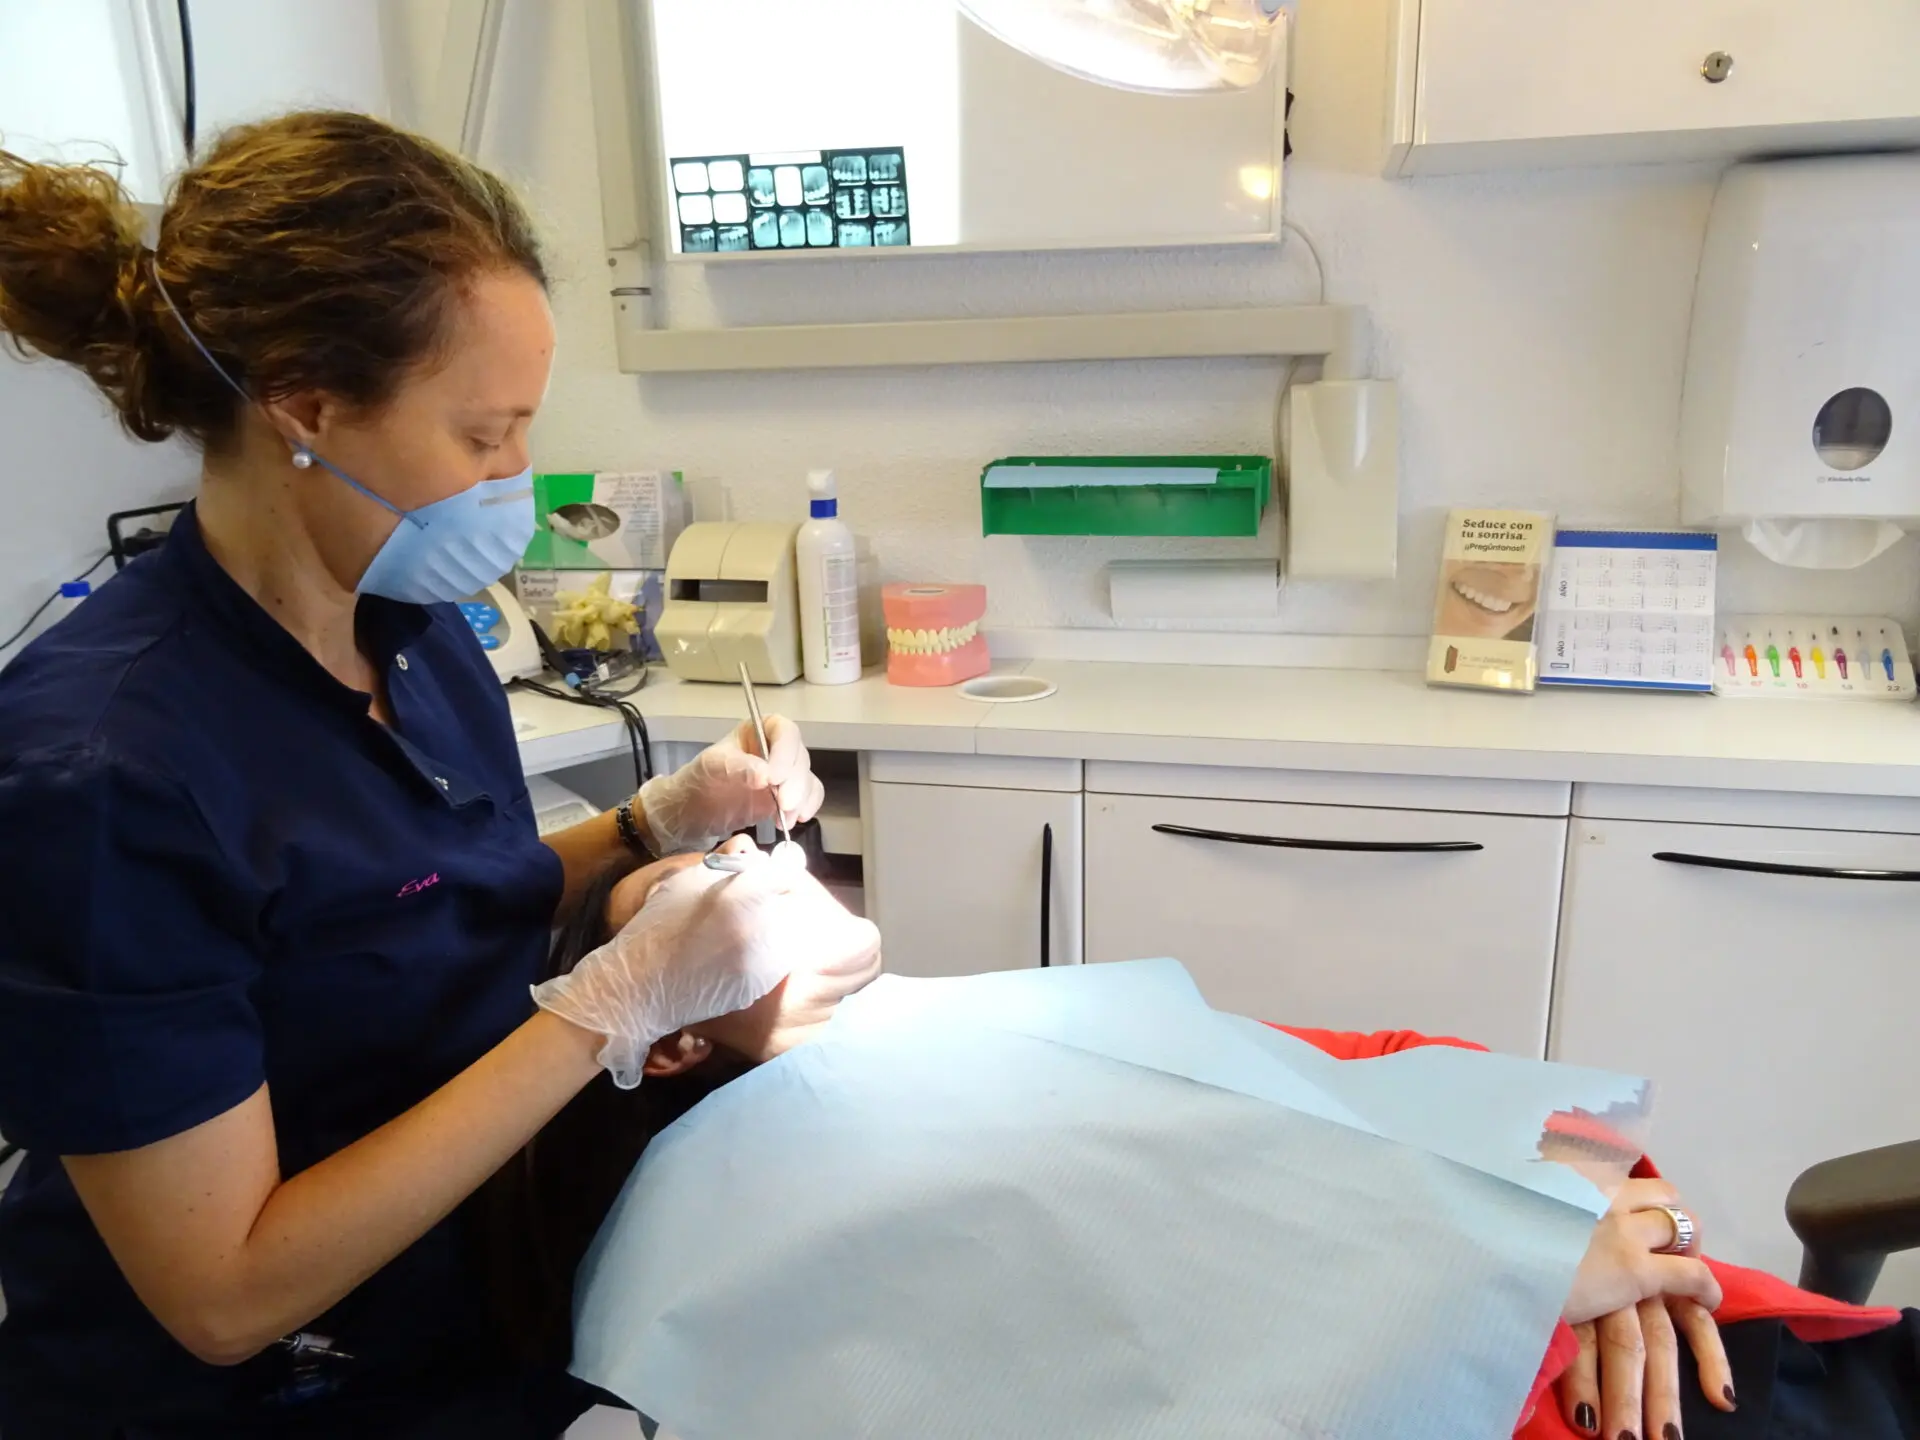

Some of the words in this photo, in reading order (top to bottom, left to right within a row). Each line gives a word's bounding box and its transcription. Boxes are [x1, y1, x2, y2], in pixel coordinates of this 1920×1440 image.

[1462, 519, 1507, 530] Seduce
[1509, 522, 1533, 530] con
[1462, 530, 1474, 538] tu
[396, 872, 440, 898] Eva
